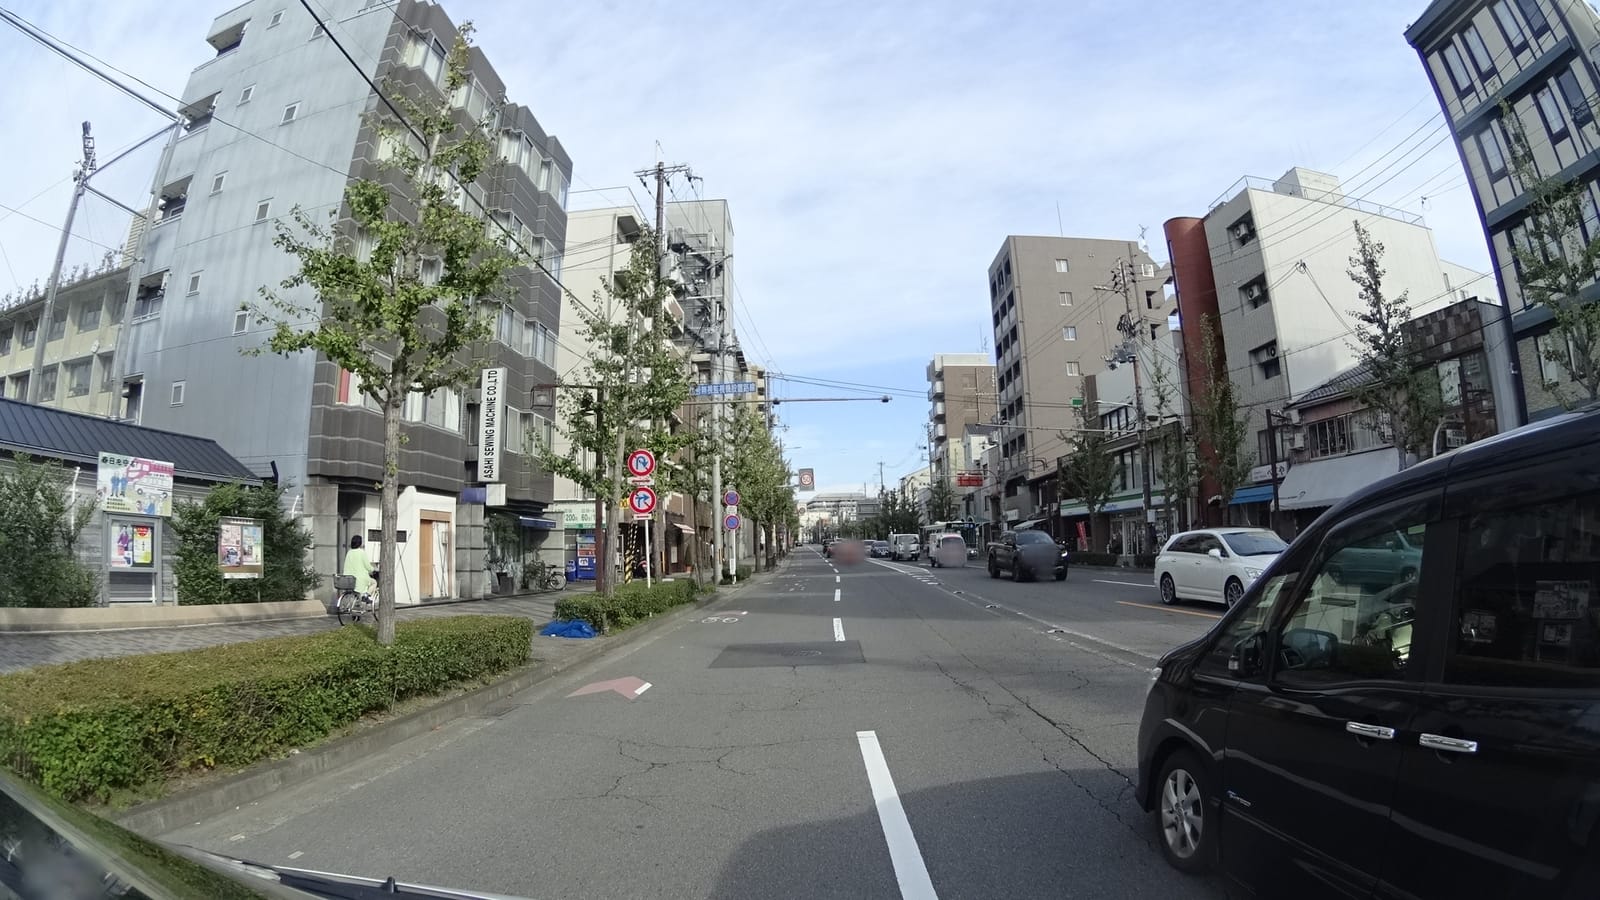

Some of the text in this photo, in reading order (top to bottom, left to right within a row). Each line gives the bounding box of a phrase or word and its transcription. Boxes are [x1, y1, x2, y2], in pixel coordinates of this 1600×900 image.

[485, 396, 496, 429] MACHINE
[484, 429, 495, 456] SEWING
[483, 457, 495, 479] ASAHI
